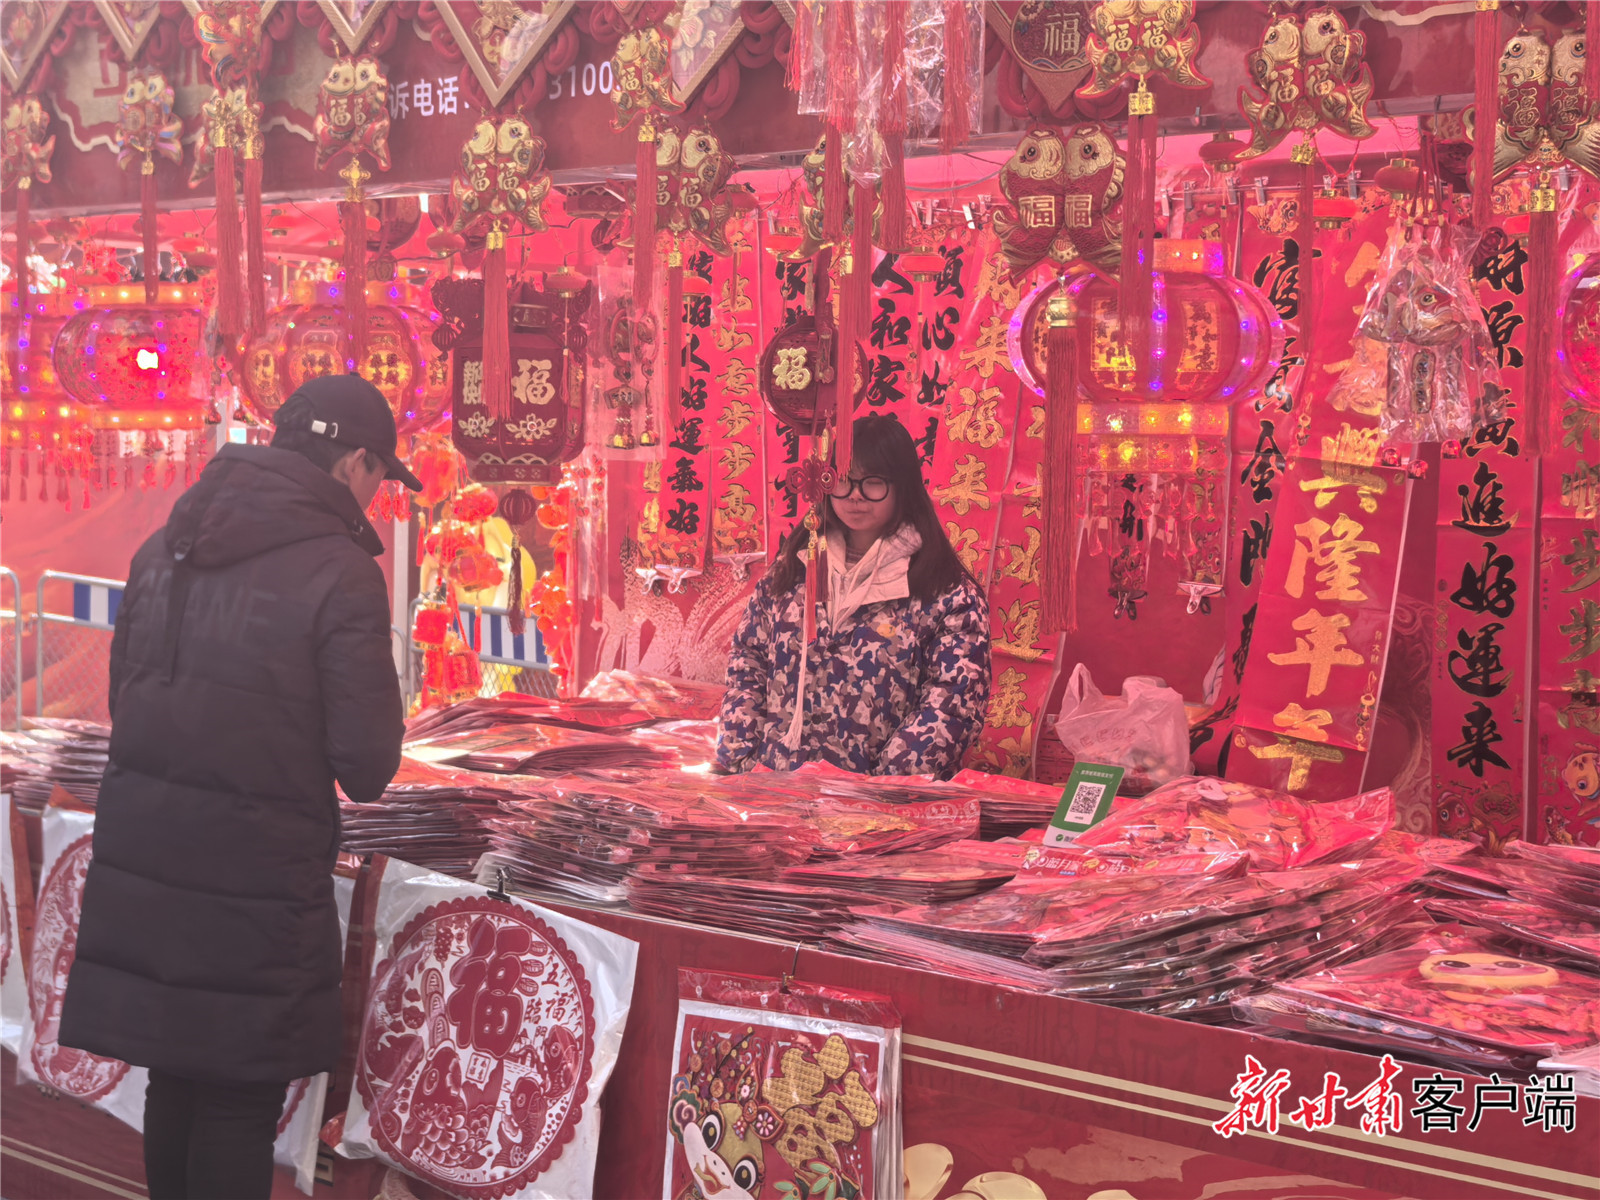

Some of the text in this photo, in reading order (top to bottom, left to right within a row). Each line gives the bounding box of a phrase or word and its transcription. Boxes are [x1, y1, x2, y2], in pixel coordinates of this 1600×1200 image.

[1045, 12, 1082, 56] 福
[1106, 20, 1168, 51] 福 福
[549, 60, 620, 100] 3100
[330, 98, 352, 126] 福
[1504, 87, 1540, 127] 福
[469, 162, 520, 192] 福 福
[679, 177, 703, 209] 福
[1018, 194, 1092, 228] 福 福
[860, 253, 913, 413] 人和家
[511, 359, 555, 405] 福
[773, 347, 811, 390] 福
[448, 917, 532, 1059] 福
